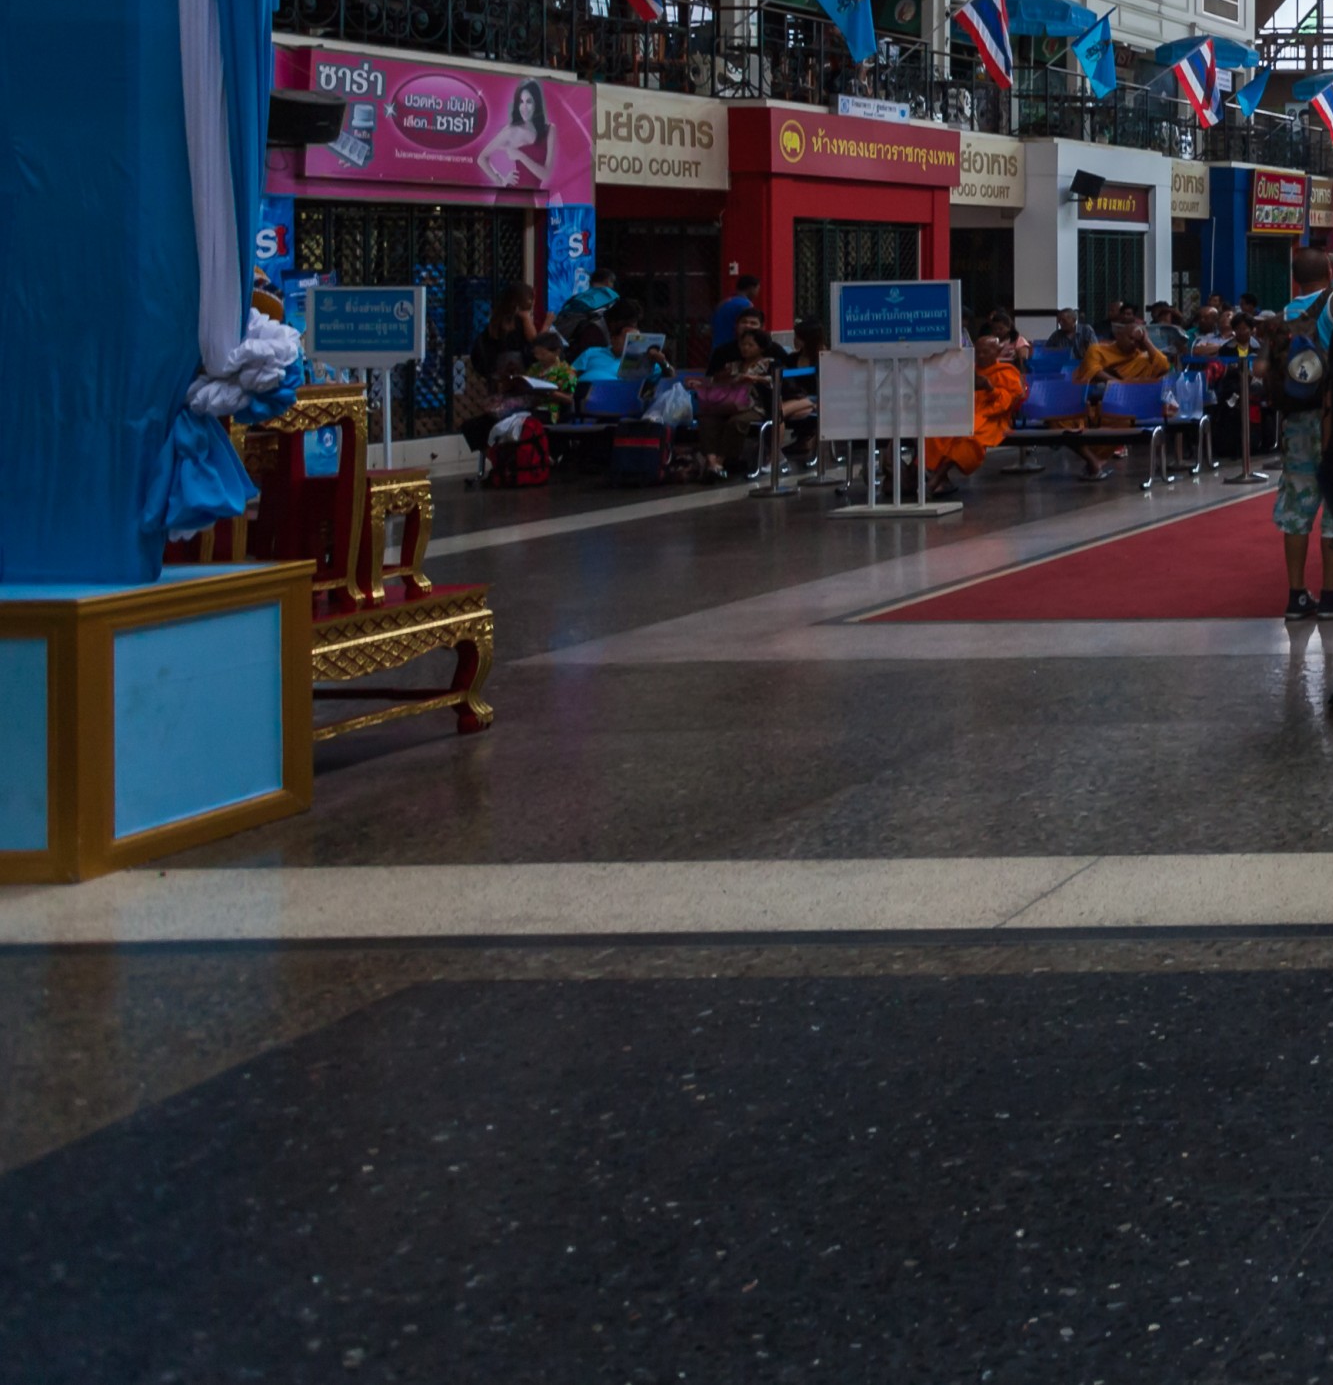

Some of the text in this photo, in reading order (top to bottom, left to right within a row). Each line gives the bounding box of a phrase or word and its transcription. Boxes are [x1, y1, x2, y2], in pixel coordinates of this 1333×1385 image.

[319, 62, 383, 96] ซาร่า
[404, 94, 443, 111] ปวดหัว
[597, 154, 702, 179] FOOD COURT
[980, 184, 1010, 199] COURT
[1178, 200, 1200, 213] COURT
[847, 325, 946, 336] RESERVED FOR MONKS
